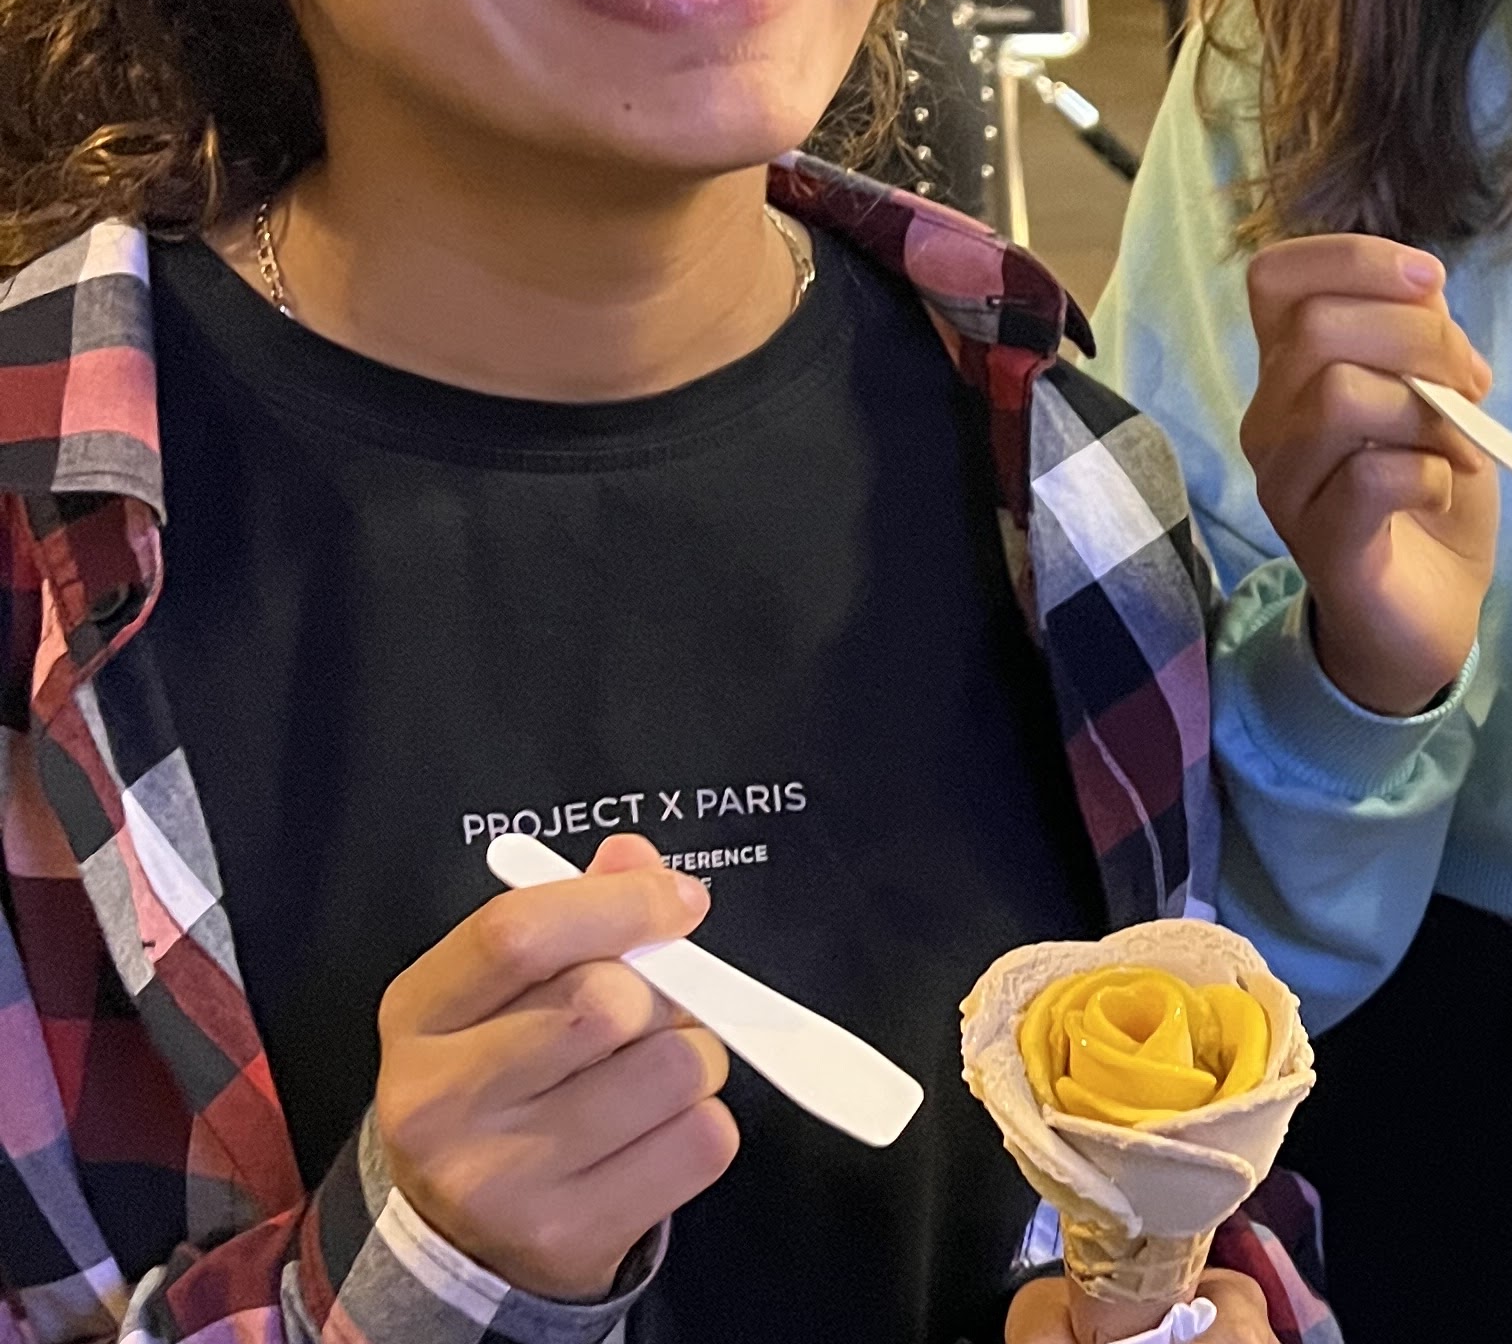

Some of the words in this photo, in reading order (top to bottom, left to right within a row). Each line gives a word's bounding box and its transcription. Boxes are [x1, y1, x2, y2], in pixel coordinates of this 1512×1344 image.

[462, 792, 645, 844] PROJECT
[659, 790, 684, 822] X
[696, 782, 807, 819] PARIS
